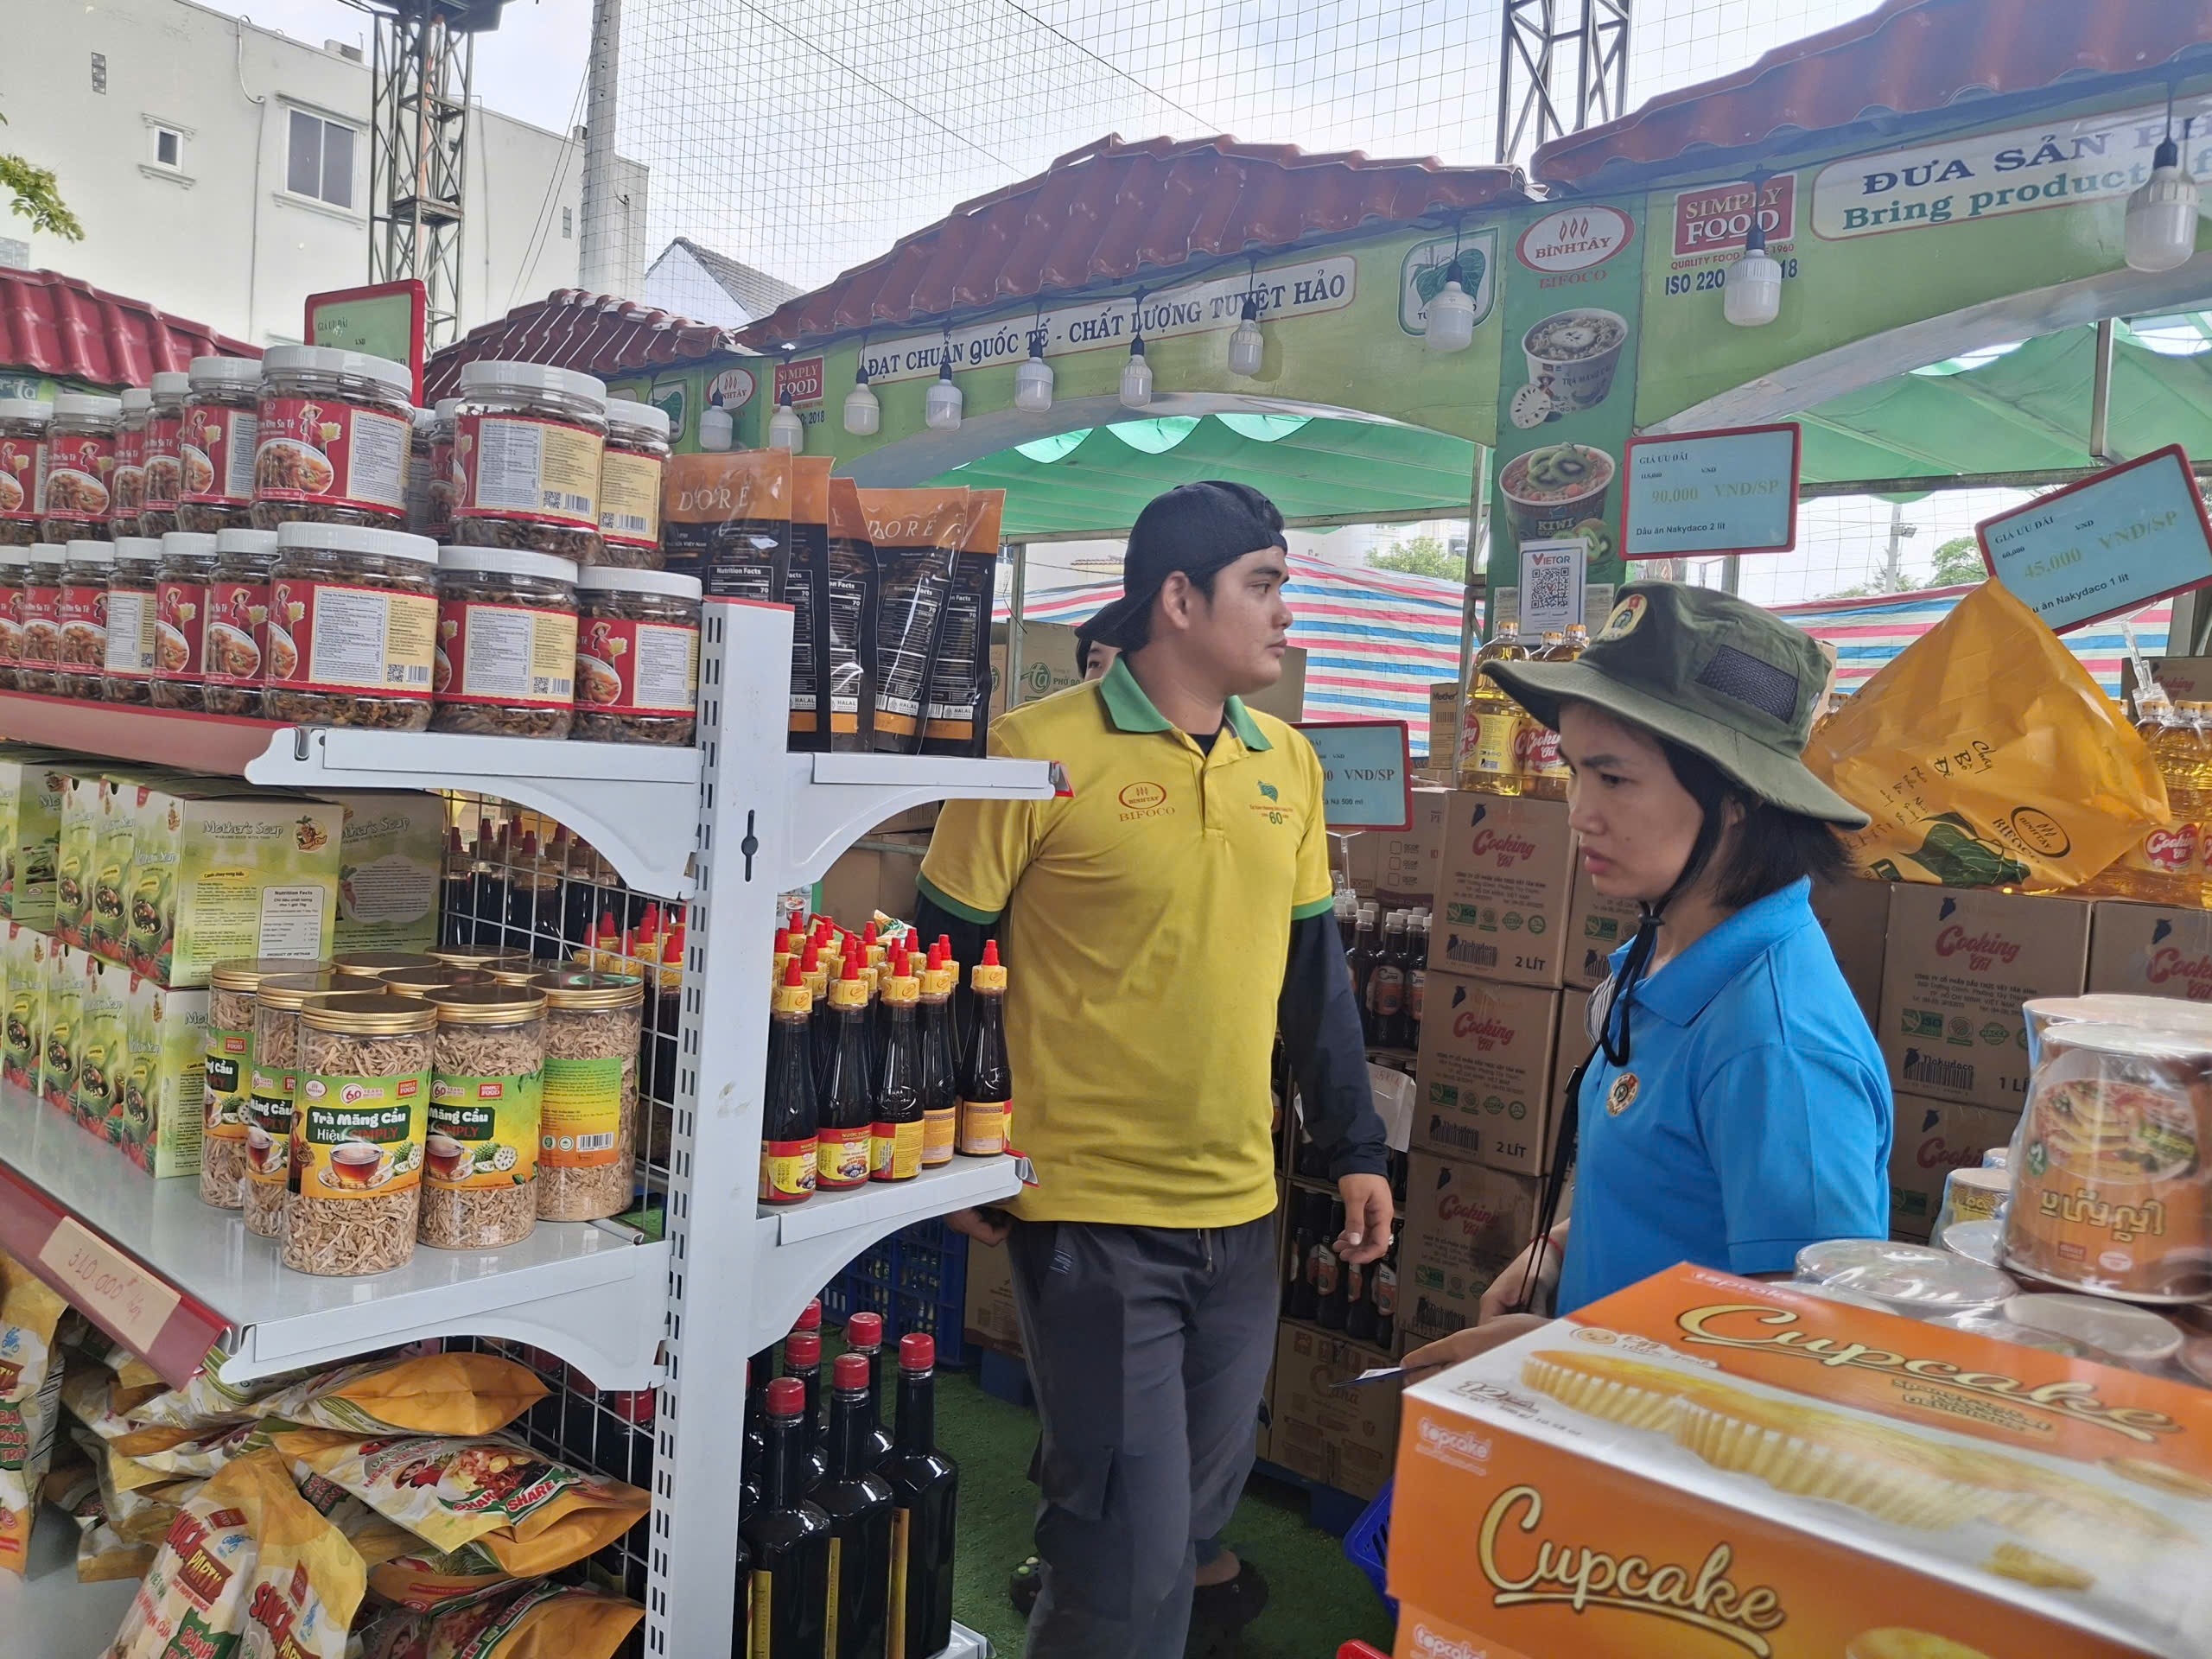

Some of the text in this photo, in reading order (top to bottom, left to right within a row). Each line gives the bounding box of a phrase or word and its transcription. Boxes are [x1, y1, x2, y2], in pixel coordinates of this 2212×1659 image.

[1862, 157, 1975, 194] ĐƯA
[1994, 133, 2112, 172] SẢN
[1685, 187, 1783, 220] SIMPLY
[1842, 195, 1955, 230] Bring
[1685, 208, 1781, 245] FOOD
[1535, 236, 1611, 259] BÌNHTÂY
[1671, 257, 1709, 270] QUALITY
[1713, 252, 1740, 264] FOOD
[1771, 244, 1794, 255] 1960
[1540, 270, 1607, 289] BIFOCO
[1665, 275, 1690, 295] ISO
[868, 270, 1345, 378] ĐẠT CHUẨN QUỐC TẾ CHẤT LƯỢNG TUYỆT HẢO
[779, 365, 819, 381] SIMPLY
[779, 378, 818, 397] FOOD
[808, 410, 825, 424] 2018
[1639, 454, 1656, 464] GIÁ
[1673, 451, 1688, 461] ĐÃI
[1713, 480, 1780, 499] VND/SP
[1537, 518, 1575, 531] KIWI
[1636, 527, 1652, 536] Dầu
[1666, 523, 1707, 535] Nakydaco
[1717, 522, 1726, 531] lít
[1994, 529, 2015, 545] GIÁ
[2034, 515, 2054, 530] ĐÃI
[2075, 519, 2094, 531] VND
[2098, 510, 2177, 551] VND/SP
[920, 588, 933, 596] acts
[2056, 582, 2107, 605] Nakydaco
[2109, 576, 2116, 587] 1
[2118, 572, 2130, 584] lít
[1053, 676, 1069, 685] PHỞ
[837, 698, 857, 708] HALAL
[899, 701, 918, 709] HALAL
[1344, 769, 1395, 781] VND/SP
[1119, 806, 1176, 822] BIFOCO
[1268, 810, 1283, 824] 60
[203, 820, 284, 838] Mother's Soup
[381, 817, 410, 830] Soup
[1472, 830, 1535, 861] Cooking
[1497, 852, 1516, 868] Oil
[1936, 925, 2021, 963] Cooking
[1515, 956, 1546, 971] 2 LÍT
[1969, 953, 1993, 971] Oil
[1452, 1011, 1516, 1046] Cooking
[1922, 1016, 1943, 1027] ISO
[1477, 1037, 1495, 1052] Oil
[214, 1059, 233, 1075] Cầu
[399, 1086, 416, 1095] FOOD
[435, 1085, 446, 1096] 60
[1999, 1077, 2005, 1090] 1
[346, 1090, 362, 1103] 60
[271, 1101, 292, 1116] Cầu
[461, 1107, 489, 1123] Cầu
[312, 1108, 406, 1128] Trà Mãng Cầu
[317, 1127, 399, 1143] Hiệu SIMPLY
[439, 1125, 480, 1139] SIMPLY
[1497, 1141, 1527, 1158] 2 LÍT
[1439, 1193, 1500, 1230] Cooking
[1675, 1303, 2181, 1441] Cupcake
[1420, 1417, 1491, 1460] topcake
[506, 1479, 556, 1512] SHARE
[187, 1548, 224, 1586] PARTY
[1478, 1484, 1786, 1652] Cupcake
